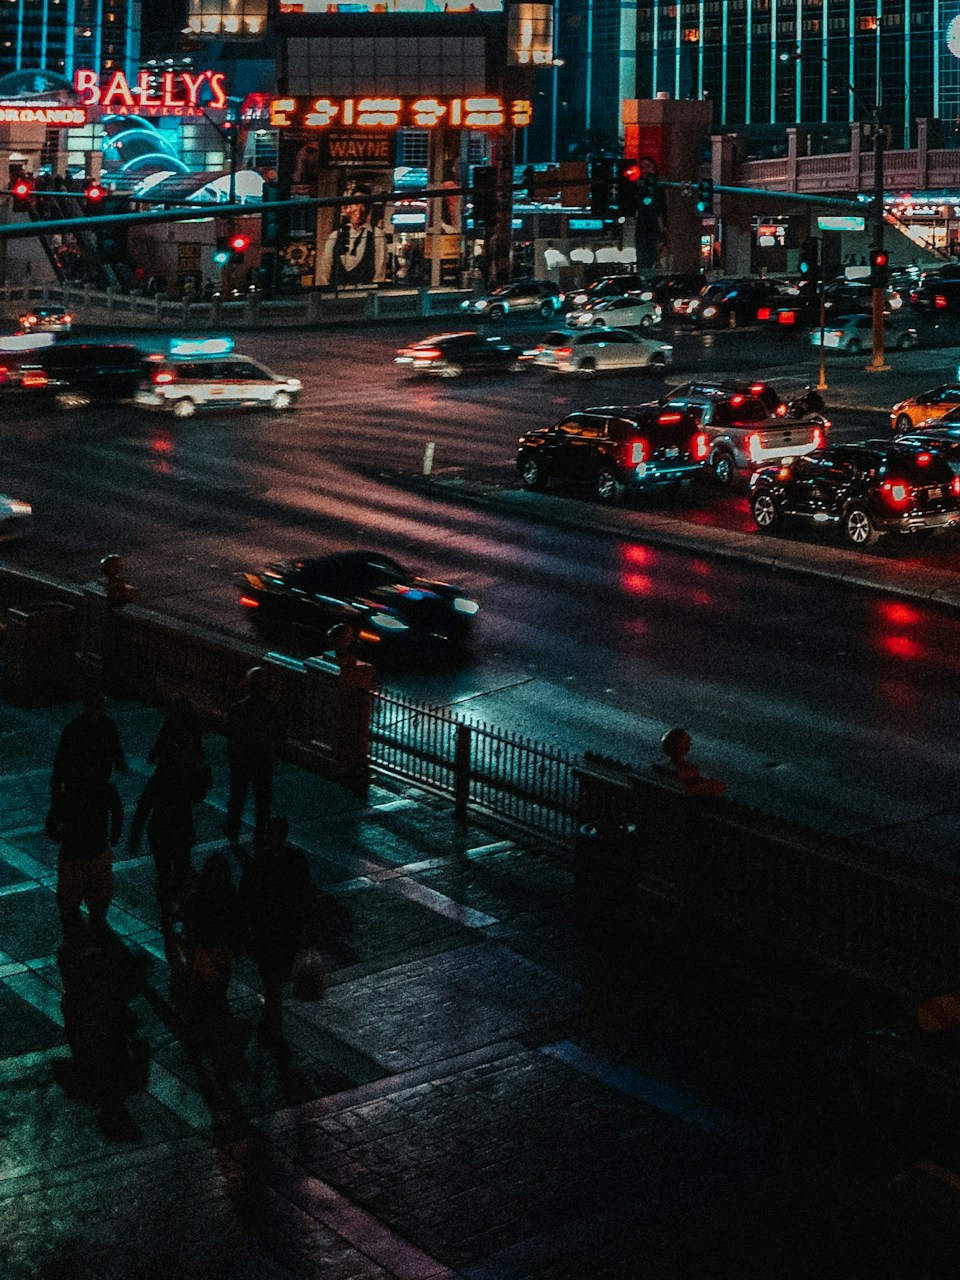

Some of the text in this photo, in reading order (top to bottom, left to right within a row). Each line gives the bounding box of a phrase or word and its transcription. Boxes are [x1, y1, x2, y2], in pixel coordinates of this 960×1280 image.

[75, 68, 227, 109] BALLY'S
[106, 106, 204, 116] LAS VEGAS
[329, 141, 389, 157] WAYNE
